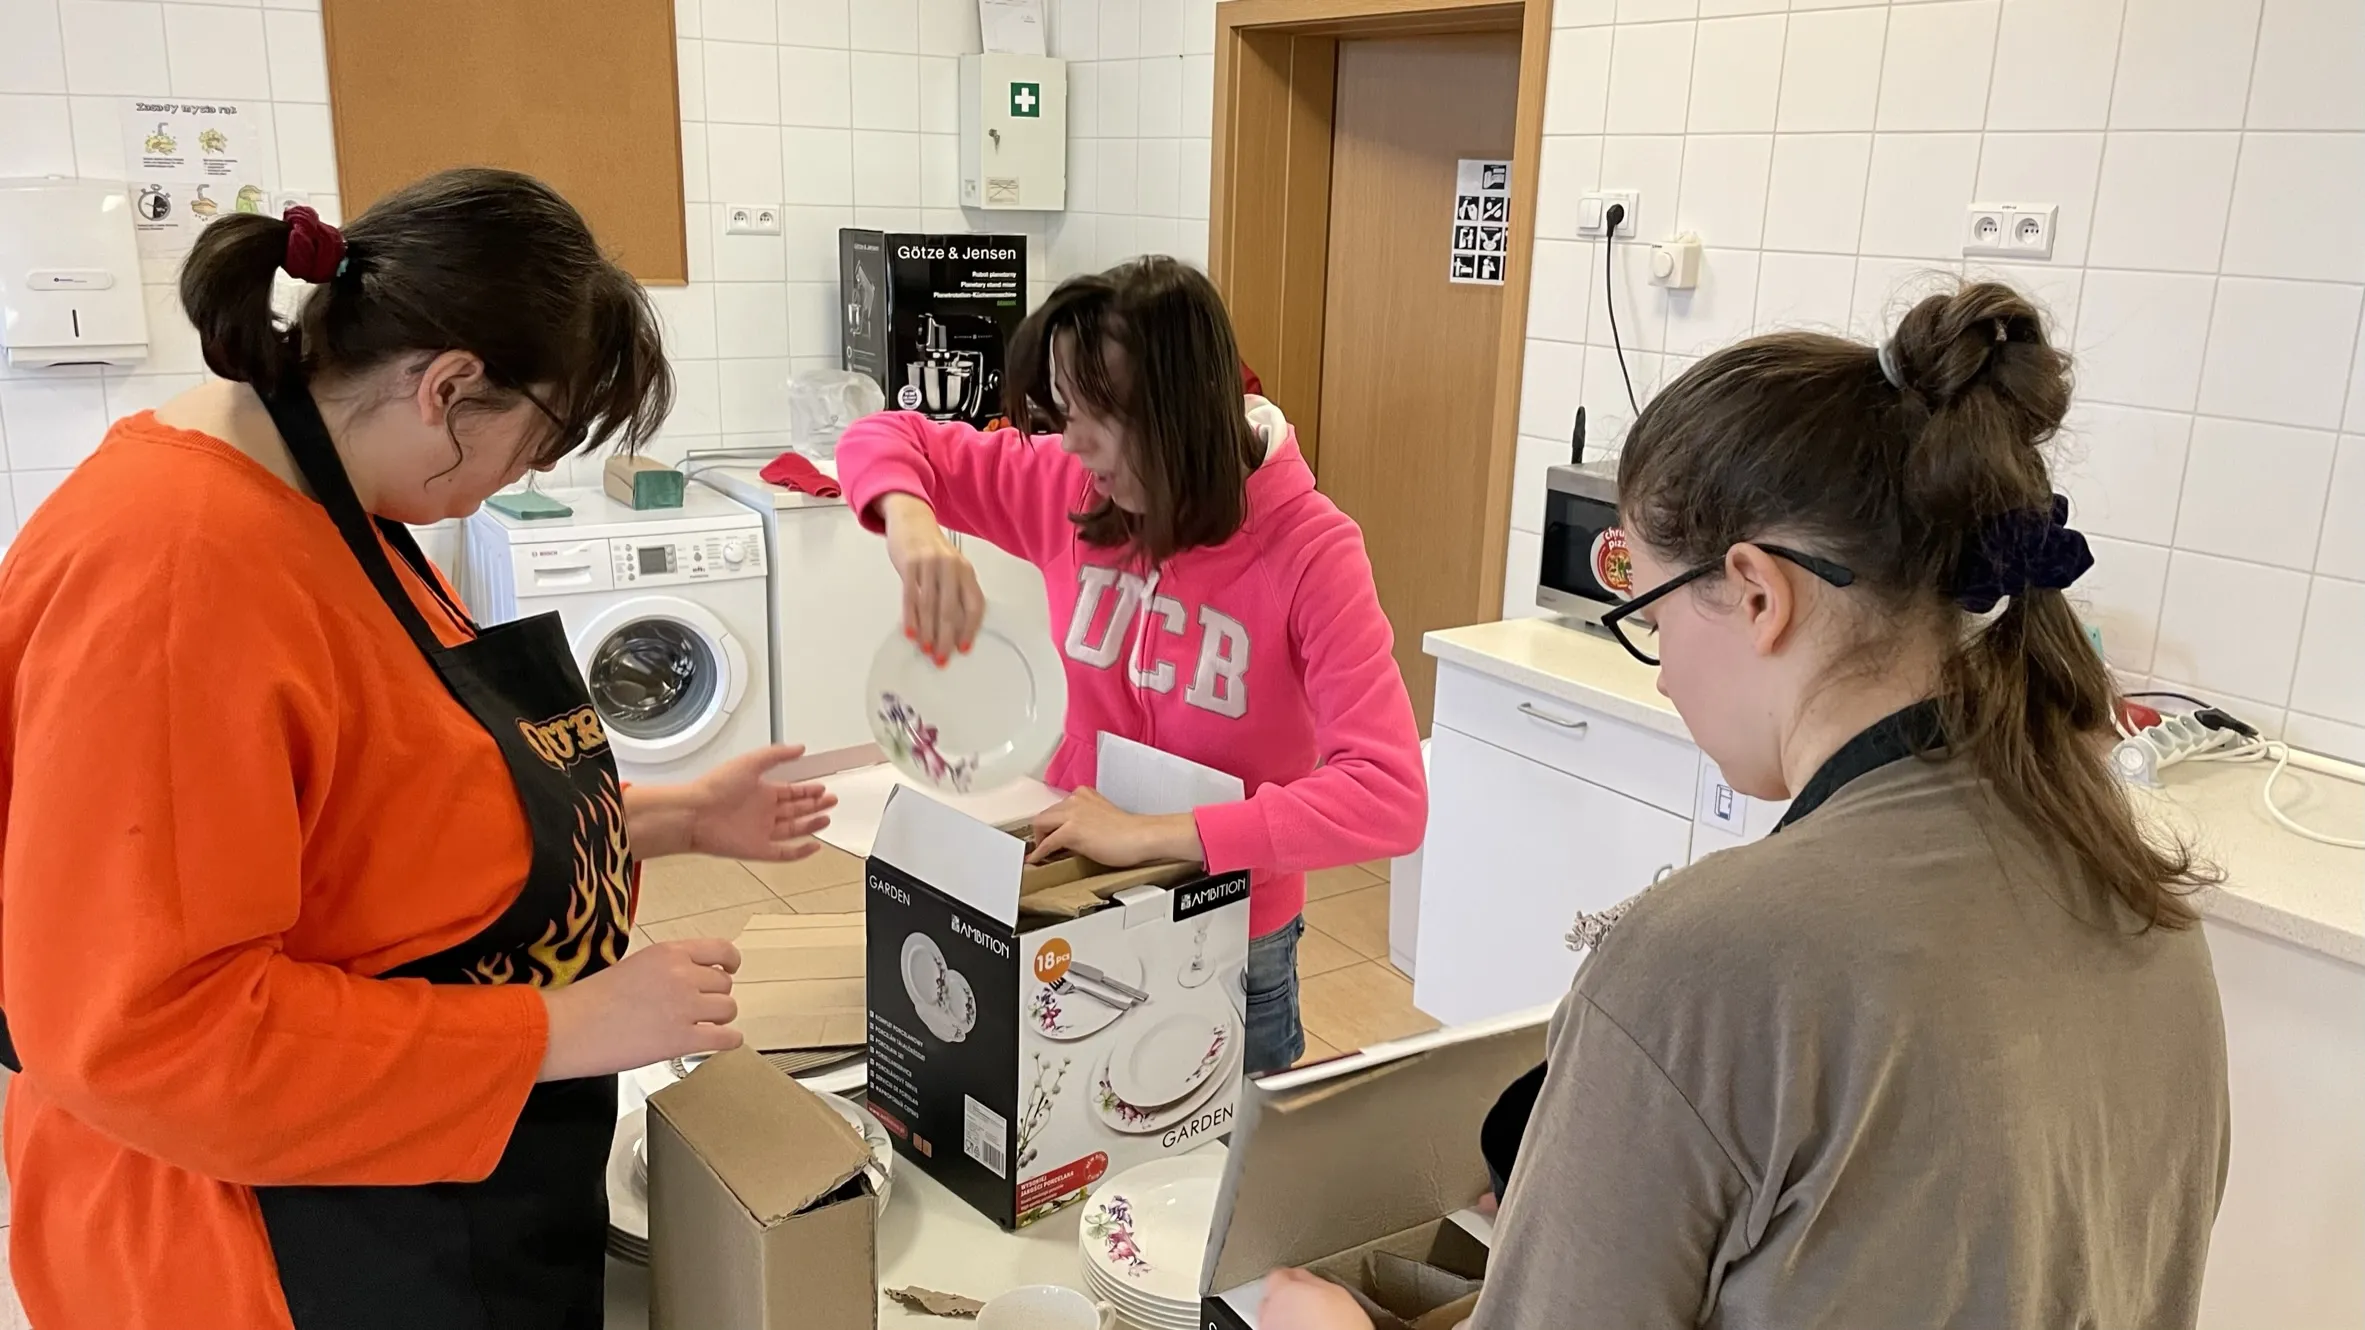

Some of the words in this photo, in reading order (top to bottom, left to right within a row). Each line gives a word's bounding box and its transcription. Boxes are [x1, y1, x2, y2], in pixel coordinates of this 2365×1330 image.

[897, 246, 945, 260] Götze
[948, 246, 959, 260] &
[962, 246, 1017, 260] Jensen
[1608, 540, 1628, 551] pizz
[1065, 565, 1249, 720] UCB
[869, 874, 911, 907] GARDEN
[1191, 877, 1246, 907] AMBITION
[960, 921, 1010, 959] AMBITION
[1037, 951, 1055, 972] 18
[1162, 1102, 1234, 1149] GARDEN
